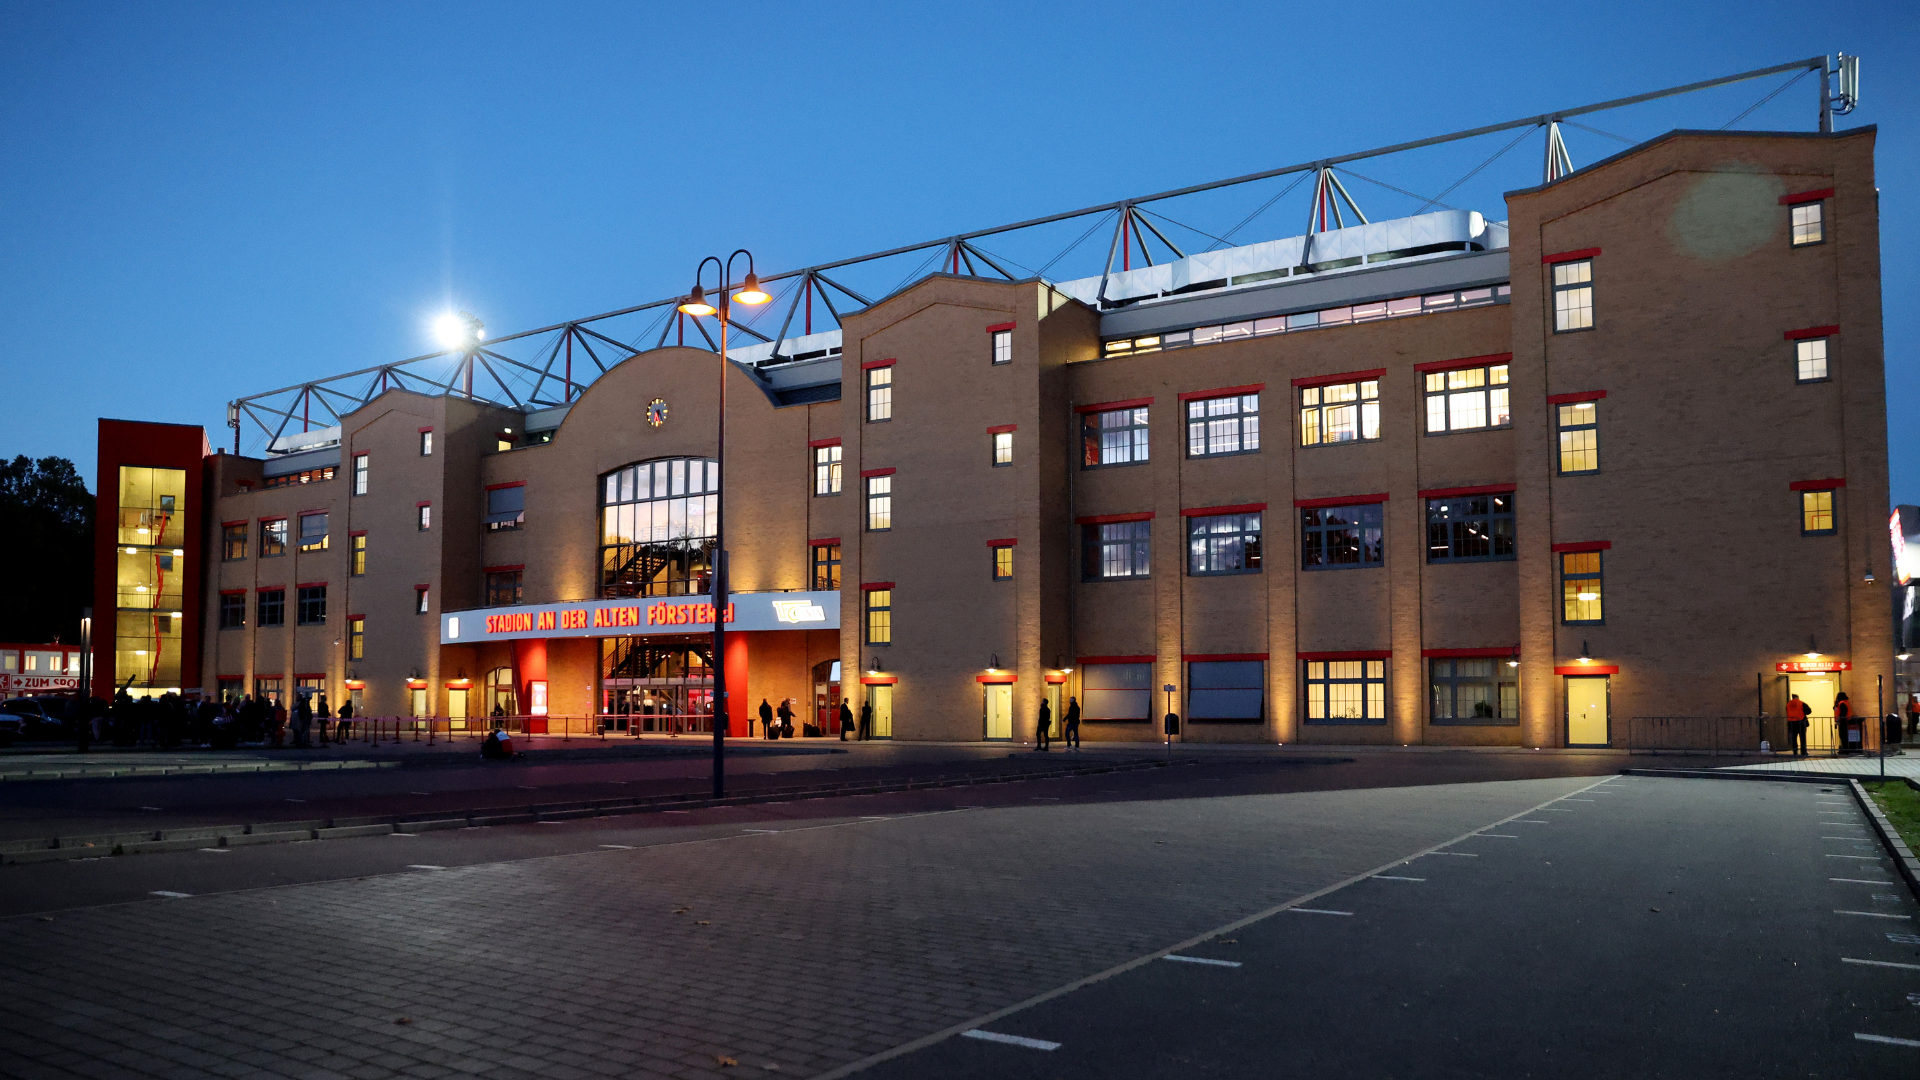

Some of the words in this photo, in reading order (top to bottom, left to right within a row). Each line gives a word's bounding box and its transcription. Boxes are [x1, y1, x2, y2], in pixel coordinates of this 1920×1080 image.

[485, 612, 533, 634] STADION
[537, 610, 556, 630] AN
[560, 609, 588, 629] DER
[593, 605, 639, 628] ALTEN
[25, 677, 50, 687] ZUM
